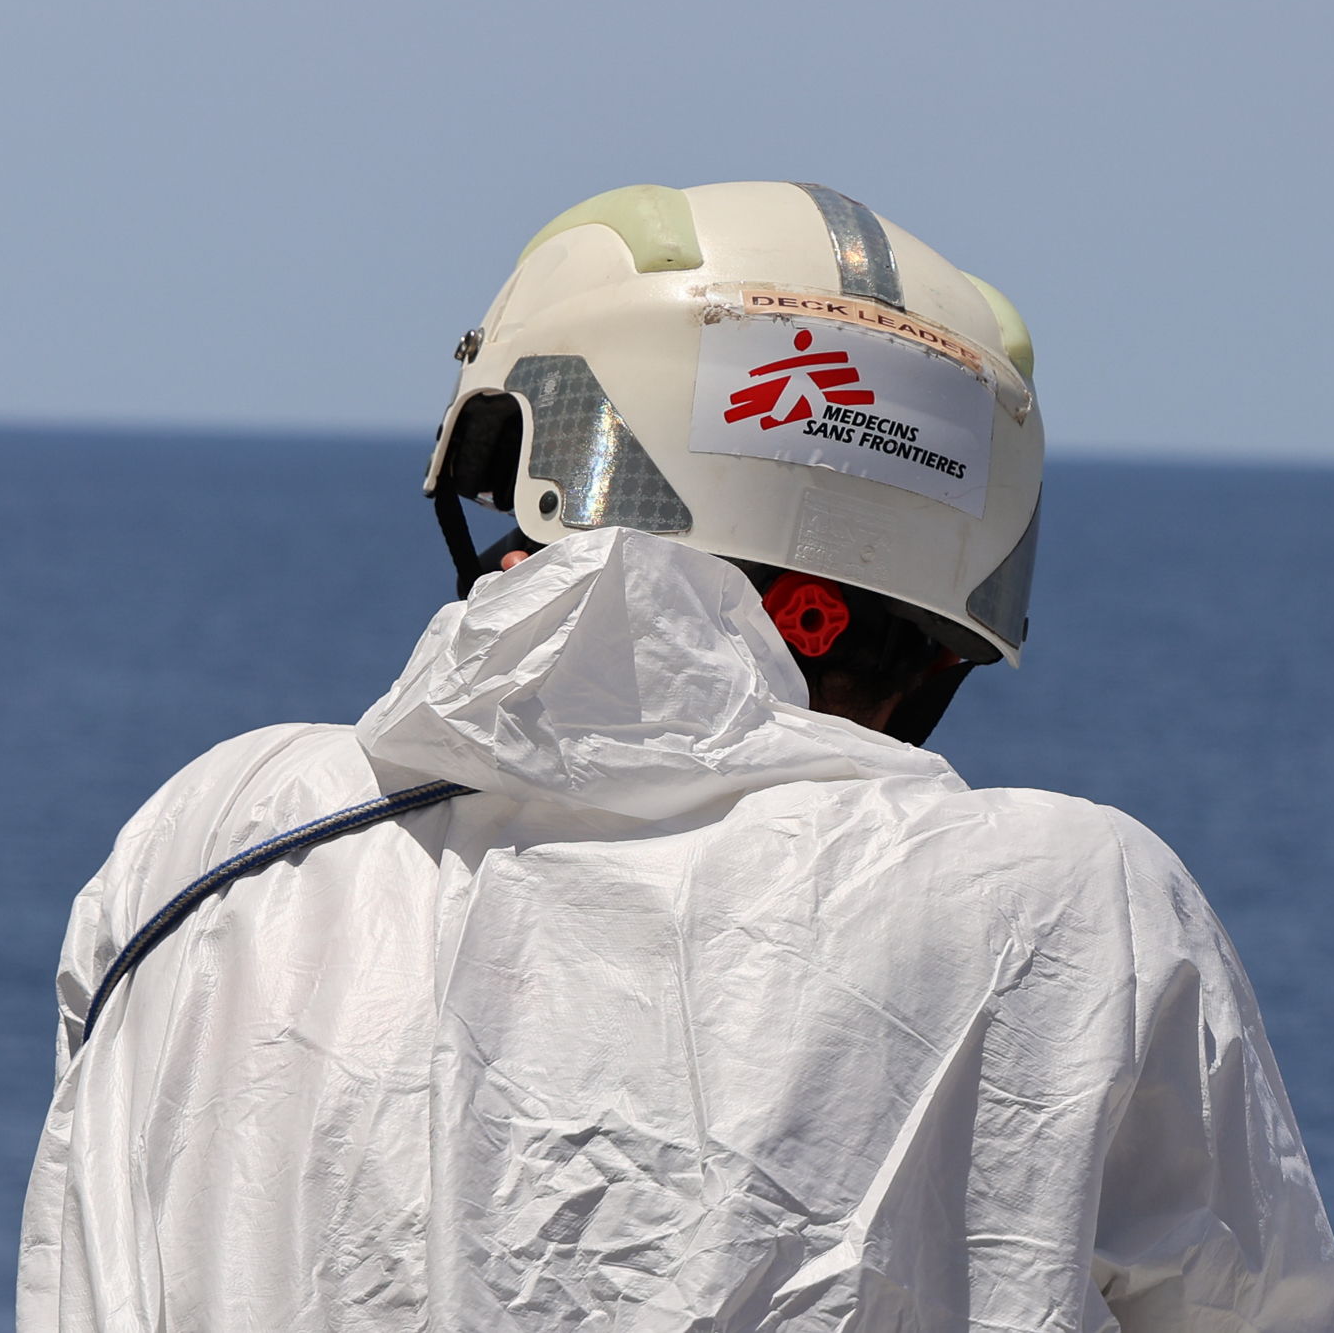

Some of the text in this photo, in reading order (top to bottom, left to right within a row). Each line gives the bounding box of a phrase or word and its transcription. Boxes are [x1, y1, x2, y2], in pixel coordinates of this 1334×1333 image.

[752, 296, 848, 316] DECK
[822, 405, 919, 442] MEDECINS
[803, 420, 967, 479] SANS FRONTIERES
